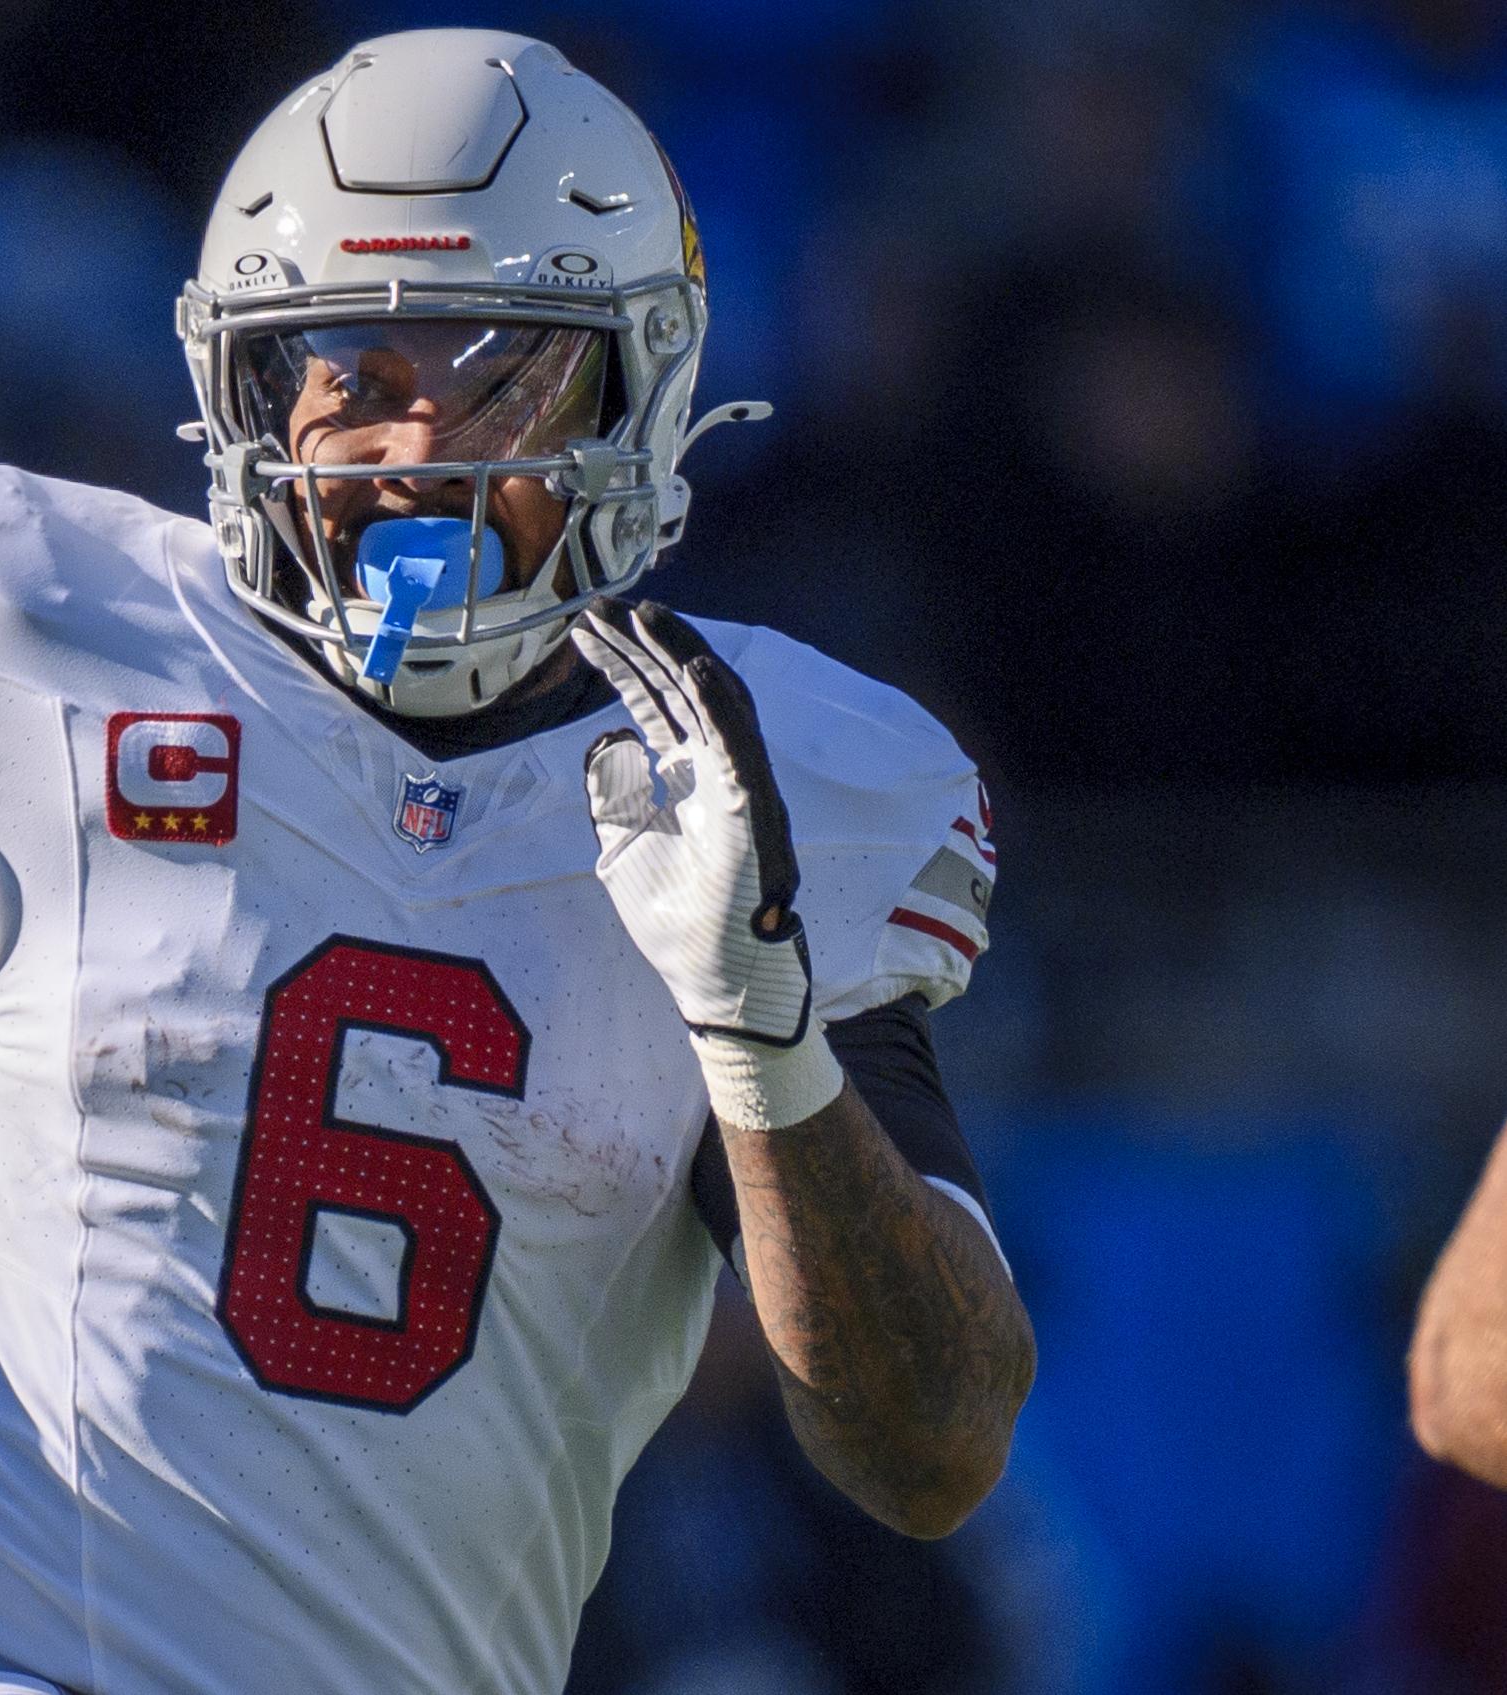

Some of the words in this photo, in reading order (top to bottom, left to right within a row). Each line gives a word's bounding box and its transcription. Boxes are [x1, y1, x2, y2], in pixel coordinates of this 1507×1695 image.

[340, 236, 471, 254] CARDINALS
[229, 273, 278, 291] OAKLEY
[538, 273, 607, 289] OAKLEY
[117, 721, 229, 808] C
[401, 801, 450, 840] NFL
[216, 932, 533, 1416] 6
